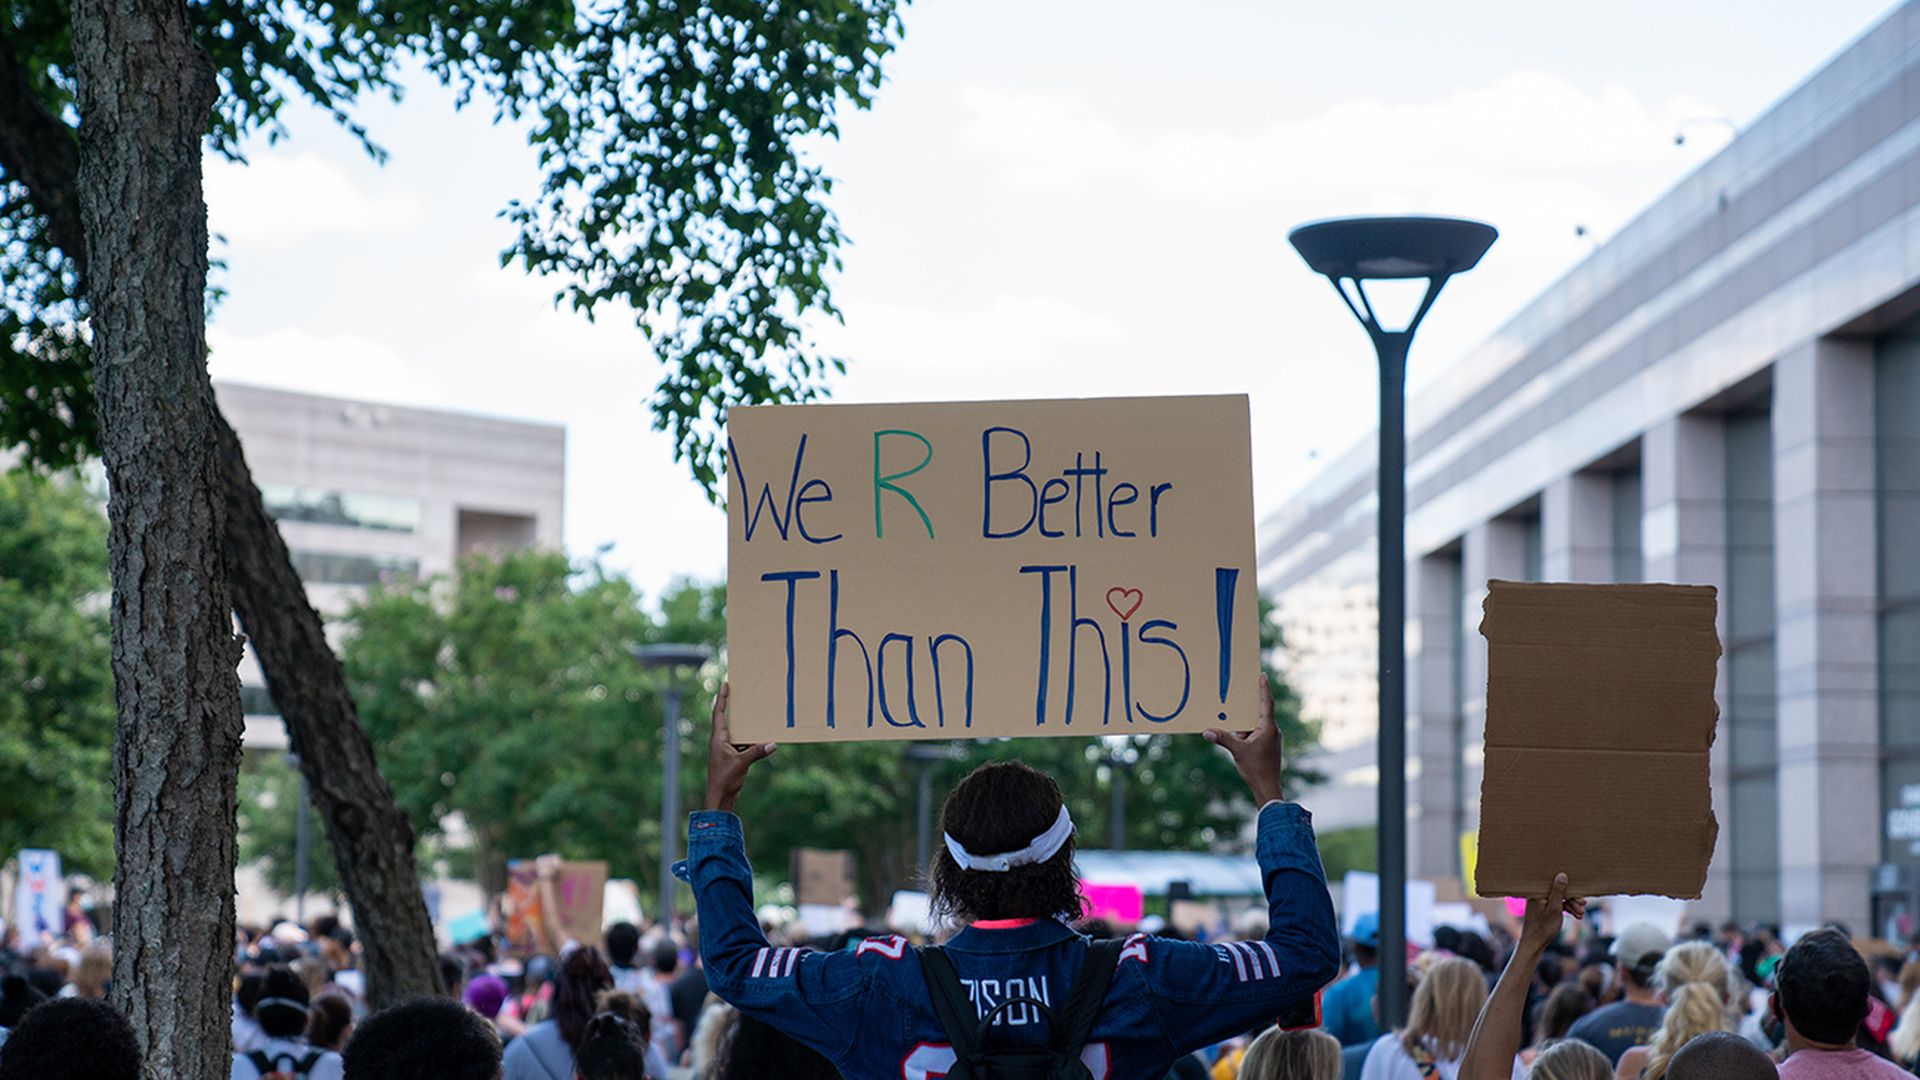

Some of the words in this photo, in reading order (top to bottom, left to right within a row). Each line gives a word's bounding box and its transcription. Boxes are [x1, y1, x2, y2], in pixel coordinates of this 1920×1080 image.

[728, 434, 842, 544] We
[874, 429, 935, 541] R
[982, 427, 1173, 539] Better
[761, 569, 974, 729] Than
[1019, 564, 1240, 727] This!
